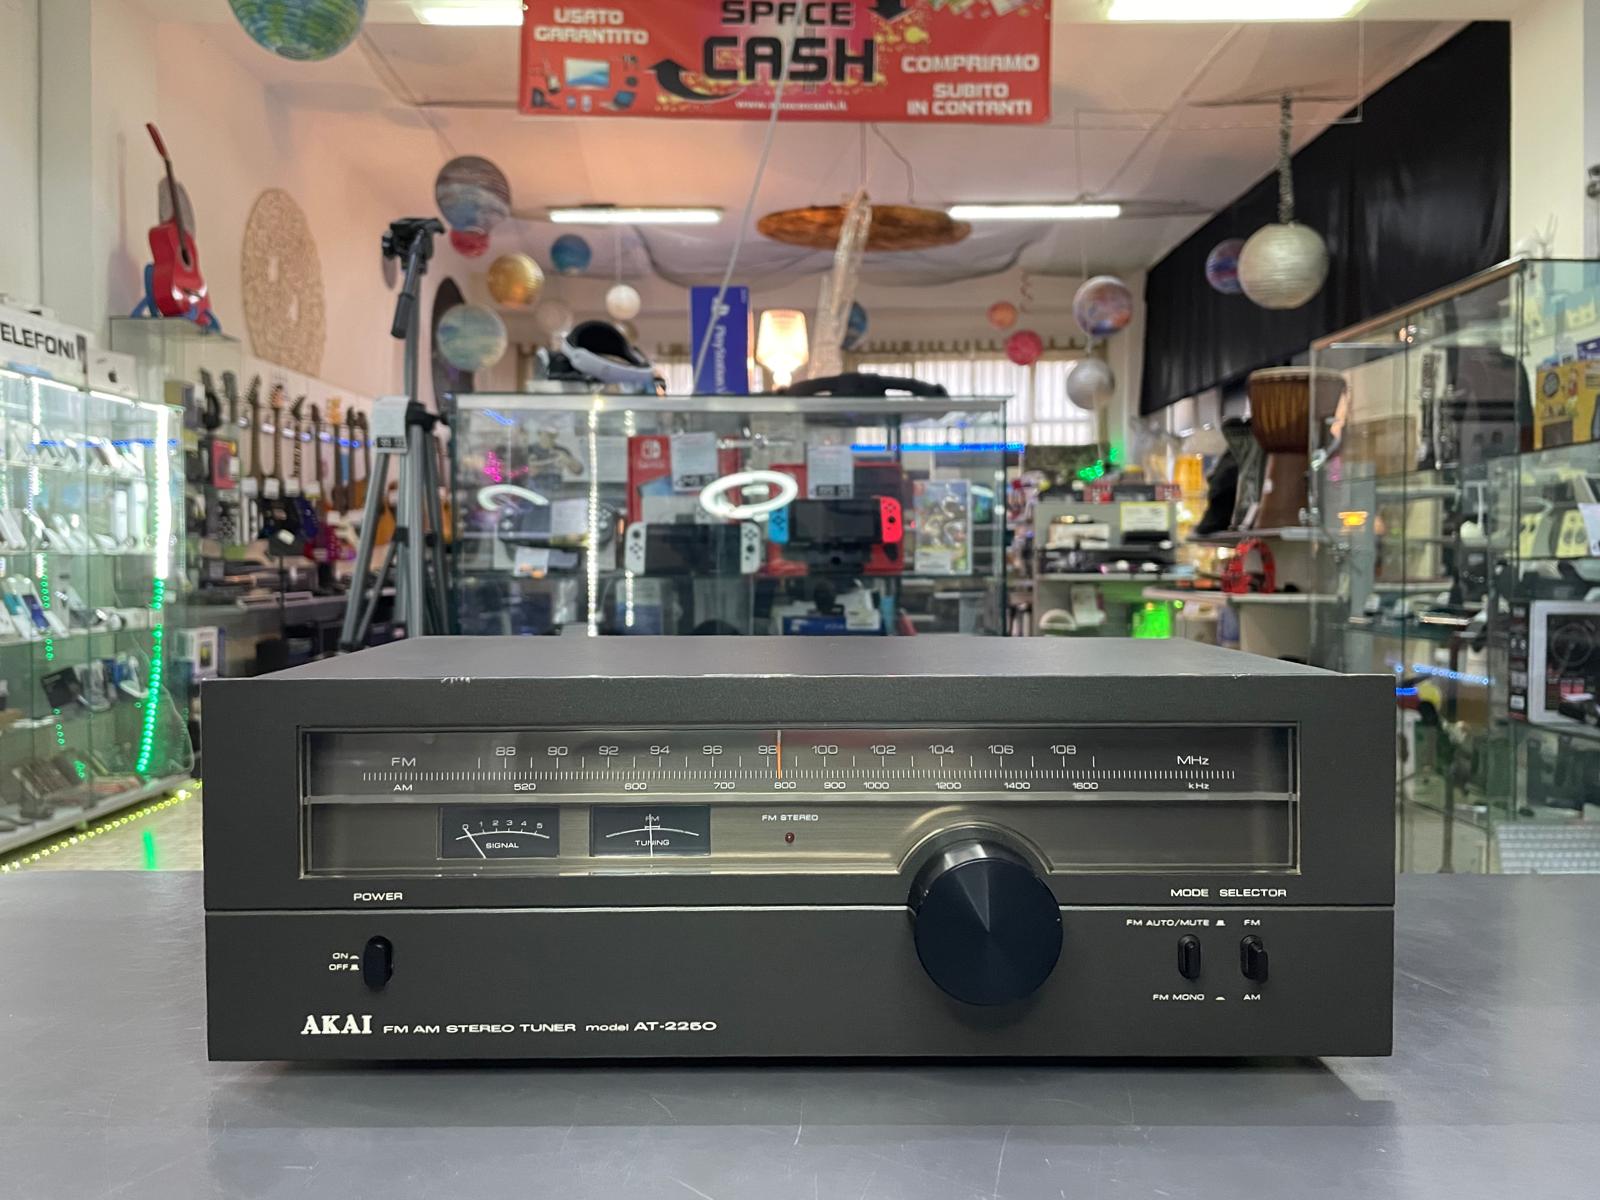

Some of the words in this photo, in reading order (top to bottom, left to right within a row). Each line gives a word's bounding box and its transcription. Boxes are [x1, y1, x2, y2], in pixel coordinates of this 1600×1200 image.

[553, 8, 624, 25] USATO
[722, 1, 851, 25] SPACE
[534, 26, 649, 45] GARANTITO
[704, 36, 874, 82] CASH
[901, 54, 1040, 72] COMPRIAMO
[932, 82, 1009, 98] SUBITO
[906, 100, 928, 116] IN
[932, 100, 1032, 116] CONTANTI
[0, 320, 75, 360] ELEFONI
[495, 746, 516, 757] 88
[547, 746, 569, 757] 90
[598, 745, 619, 756] 92
[650, 745, 671, 756] 94
[702, 744, 723, 756] 96
[758, 744, 779, 756] 98
[811, 744, 839, 755] 100
[870, 744, 897, 755] 102
[928, 744, 955, 755] 104
[987, 744, 1014, 755] 106
[1049, 744, 1077, 755] 108
[391, 757, 417, 767] FM
[1176, 755, 1210, 766] MHz
[393, 783, 413, 792] AM
[513, 783, 537, 791] 520
[624, 782, 647, 791] 600
[713, 781, 736, 790] 700
[774, 781, 797, 790] 800
[823, 781, 847, 790] 900
[863, 781, 890, 790] 1000
[935, 781, 962, 790] 1200
[1003, 781, 1031, 790] 1400
[1072, 781, 1099, 790] 1600
[1188, 781, 1210, 790] kHz
[761, 813, 777, 822] FM
[780, 813, 819, 822] STEREO
[492, 819, 499, 827] 2
[536, 822, 543, 830] 5
[485, 841, 519, 850] SIGNAL
[635, 839, 670, 847] TUNING
[353, 892, 403, 902] POWER
[1170, 888, 1209, 897] MODE
[1219, 888, 1287, 897] SELECTOR
[1126, 919, 1143, 927] FM
[1145, 919, 1210, 927] AUTO/MUTE
[332, 952, 349, 960] ON
[328, 963, 349, 972] OFF
[1172, 993, 1205, 1001] MONO
[300, 1014, 373, 1035] AKAI
[383, 1025, 409, 1034] FM
[413, 1025, 440, 1034] AM
[446, 1024, 515, 1034] STEREO
[519, 1023, 577, 1033] TUNER
[585, 1023, 629, 1032] model
[633, 1021, 718, 1032] AT-2250
